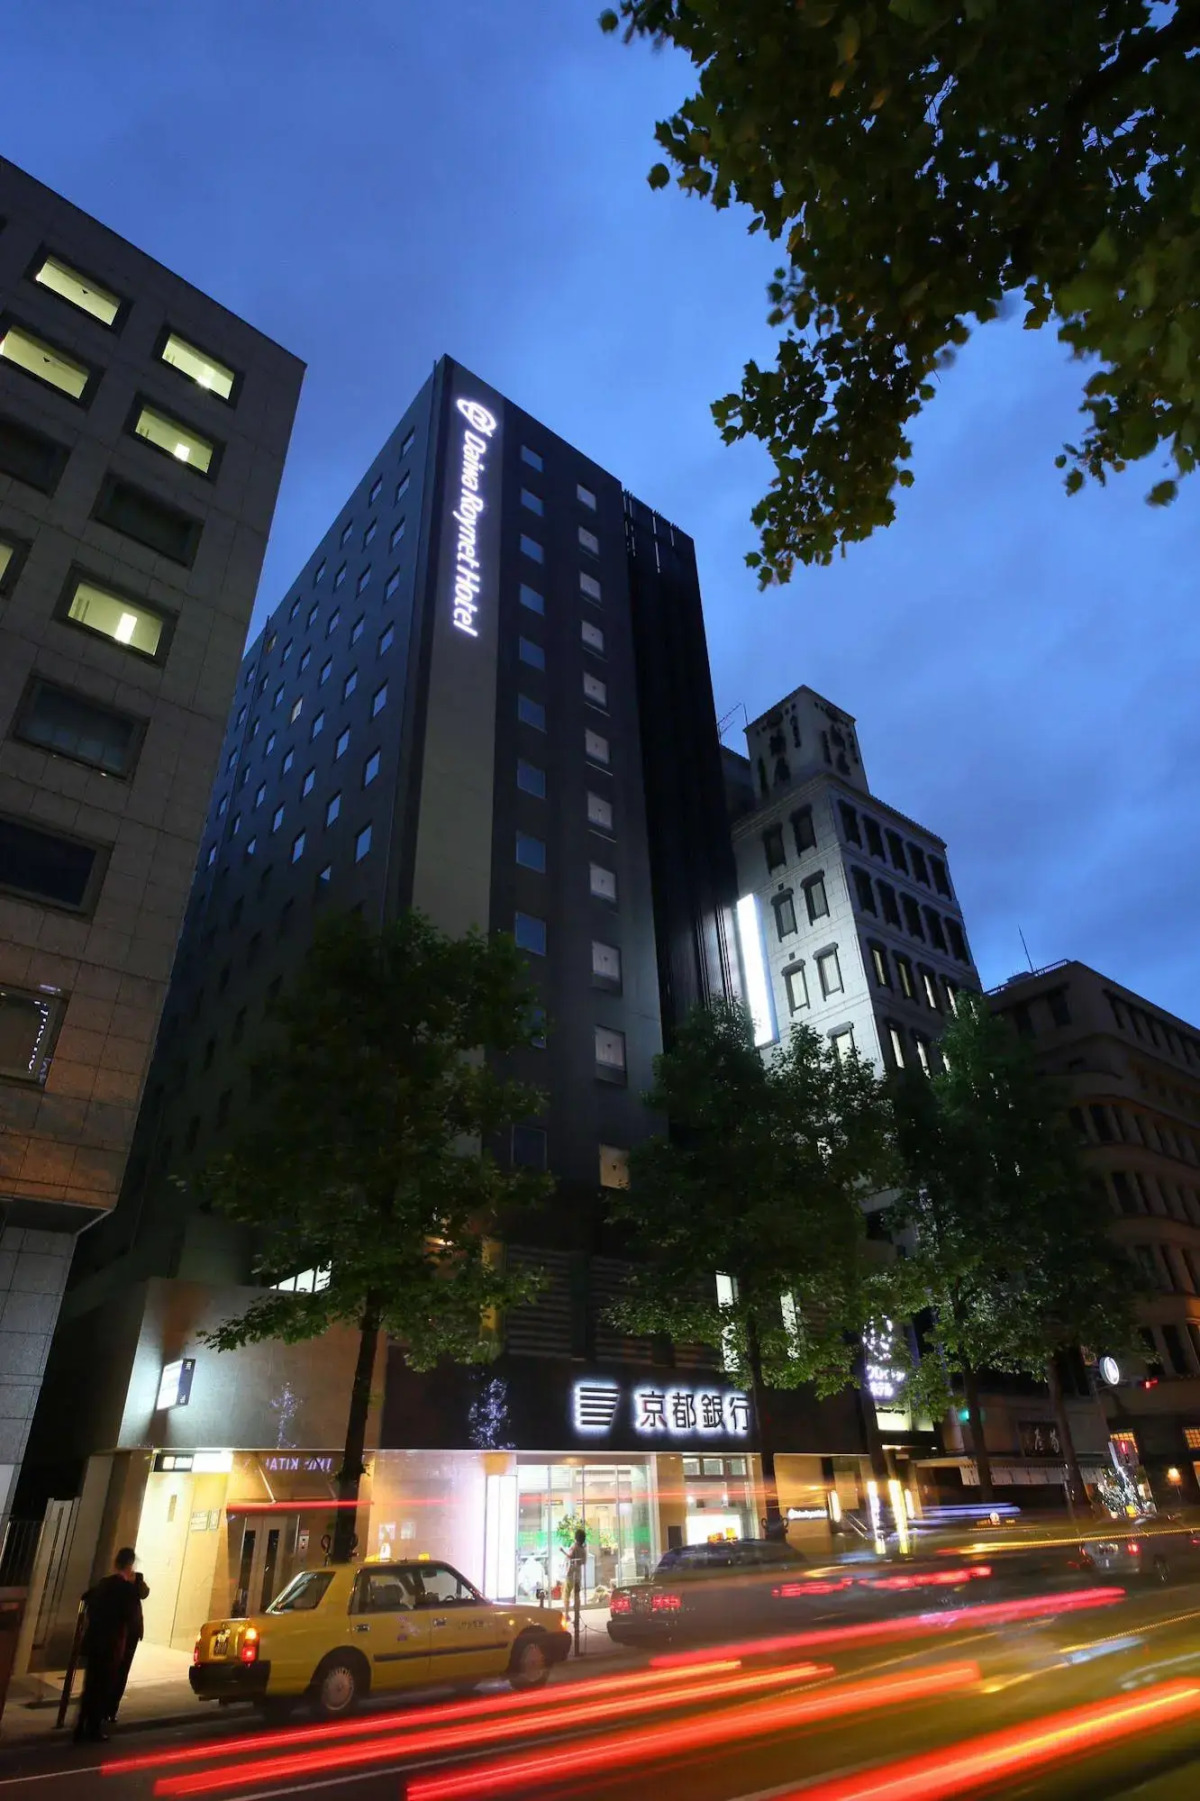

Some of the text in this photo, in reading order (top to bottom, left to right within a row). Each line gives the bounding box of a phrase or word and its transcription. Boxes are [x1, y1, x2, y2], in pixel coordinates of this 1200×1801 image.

[453, 429, 486, 637] Daiwa Roynet Hotel
[639, 1391, 750, 1430] 京都銀行
